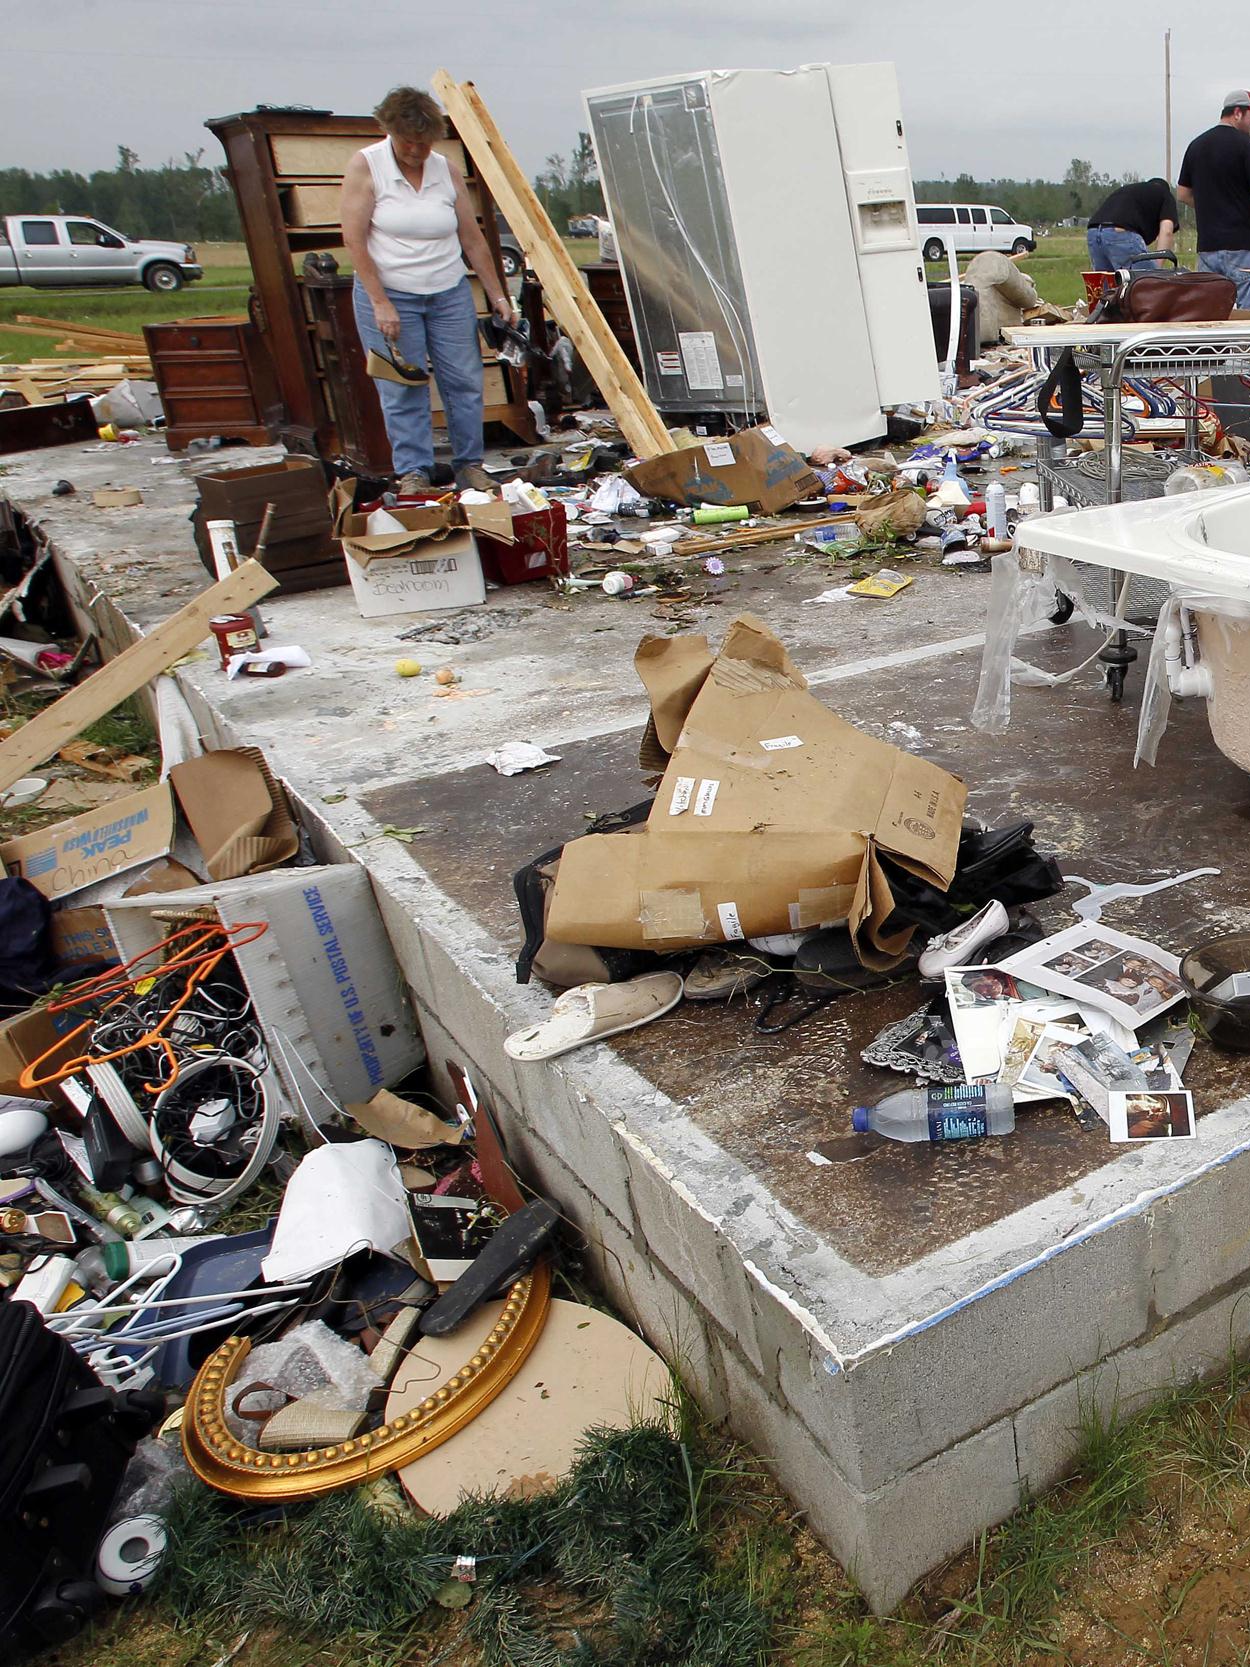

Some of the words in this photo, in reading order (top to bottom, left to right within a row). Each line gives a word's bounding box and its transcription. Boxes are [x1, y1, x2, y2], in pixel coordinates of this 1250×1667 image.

[52, 849, 141, 892] China
[302, 885, 334, 936] SERVICE
[323, 936, 350, 985] POSTAL
[347, 1010, 365, 1025] OF
[352, 1026, 385, 1086] PROPERTY
